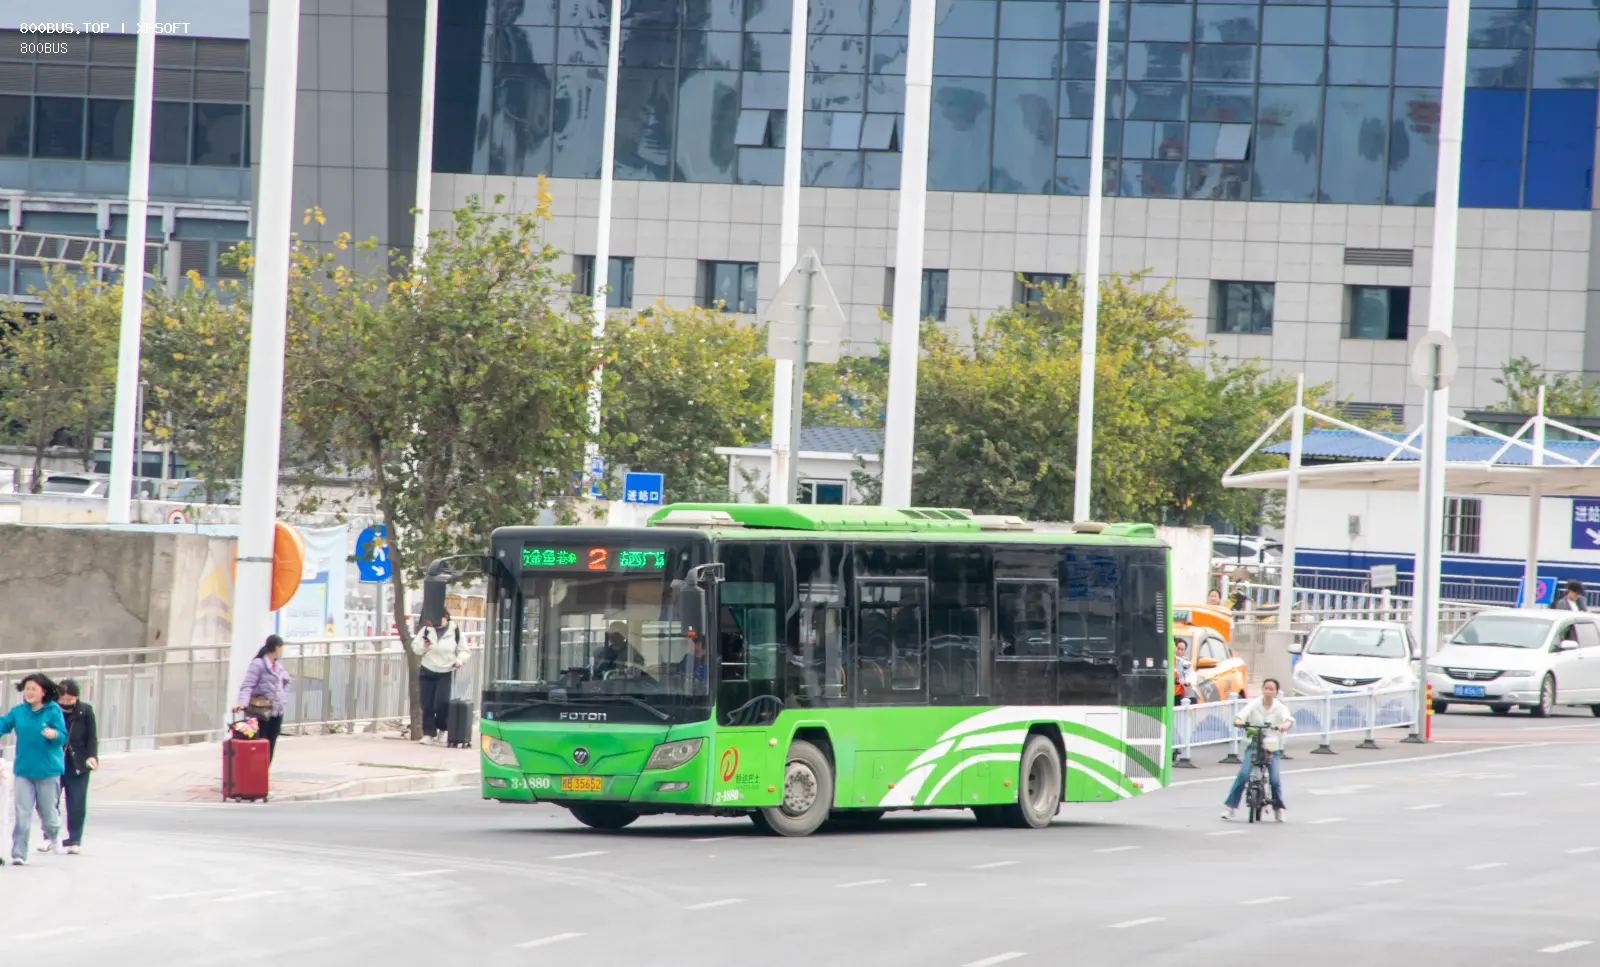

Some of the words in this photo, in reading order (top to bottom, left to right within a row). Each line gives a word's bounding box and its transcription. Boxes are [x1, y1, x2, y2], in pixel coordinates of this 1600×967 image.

[627, 489, 659, 501] 进站口
[588, 548, 607, 570] 2
[560, 712, 607, 720] FOTON
[511, 777, 550, 789] 3-1880
